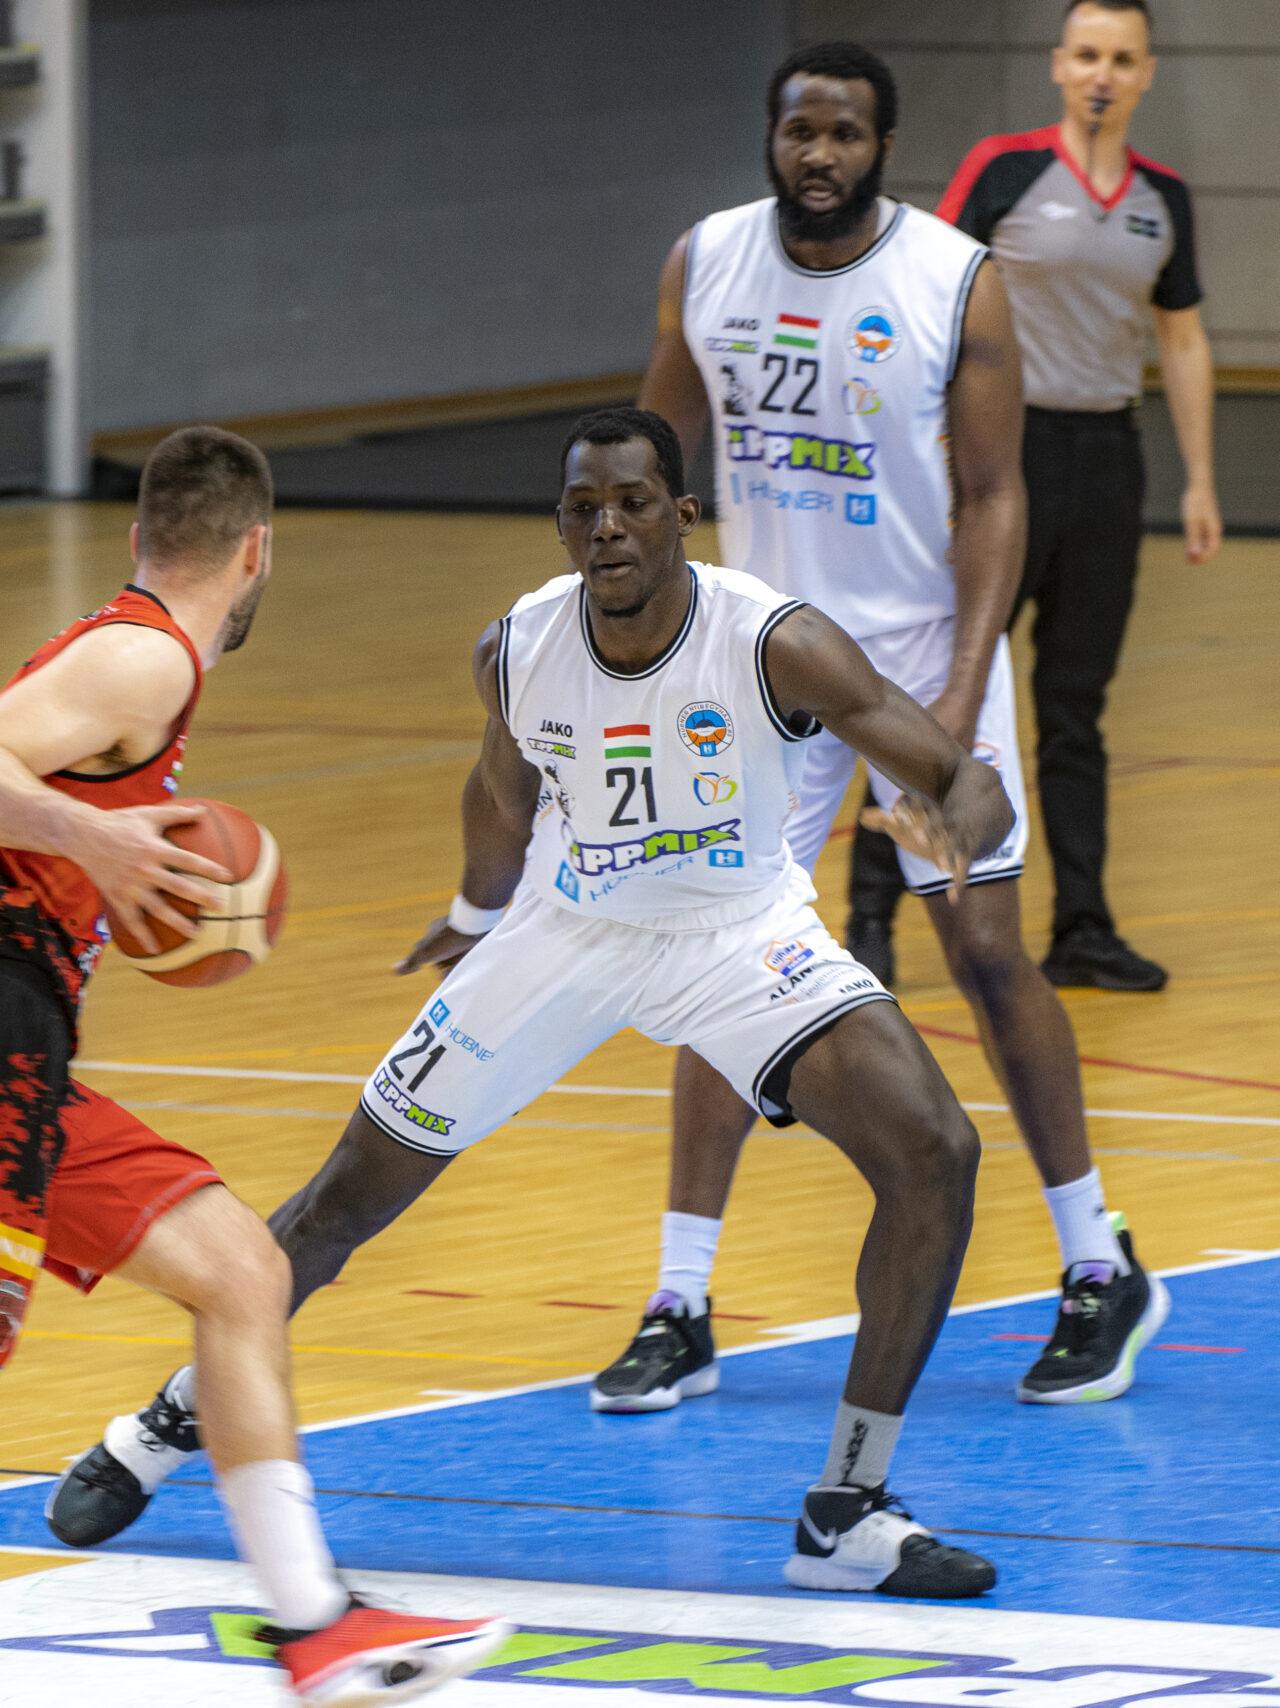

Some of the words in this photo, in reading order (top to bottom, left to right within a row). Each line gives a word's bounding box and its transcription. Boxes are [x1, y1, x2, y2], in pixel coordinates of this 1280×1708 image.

[759, 353, 819, 416] 22
[540, 719, 573, 738] JAKO
[606, 766, 657, 827] 21
[388, 1019, 447, 1093] 21
